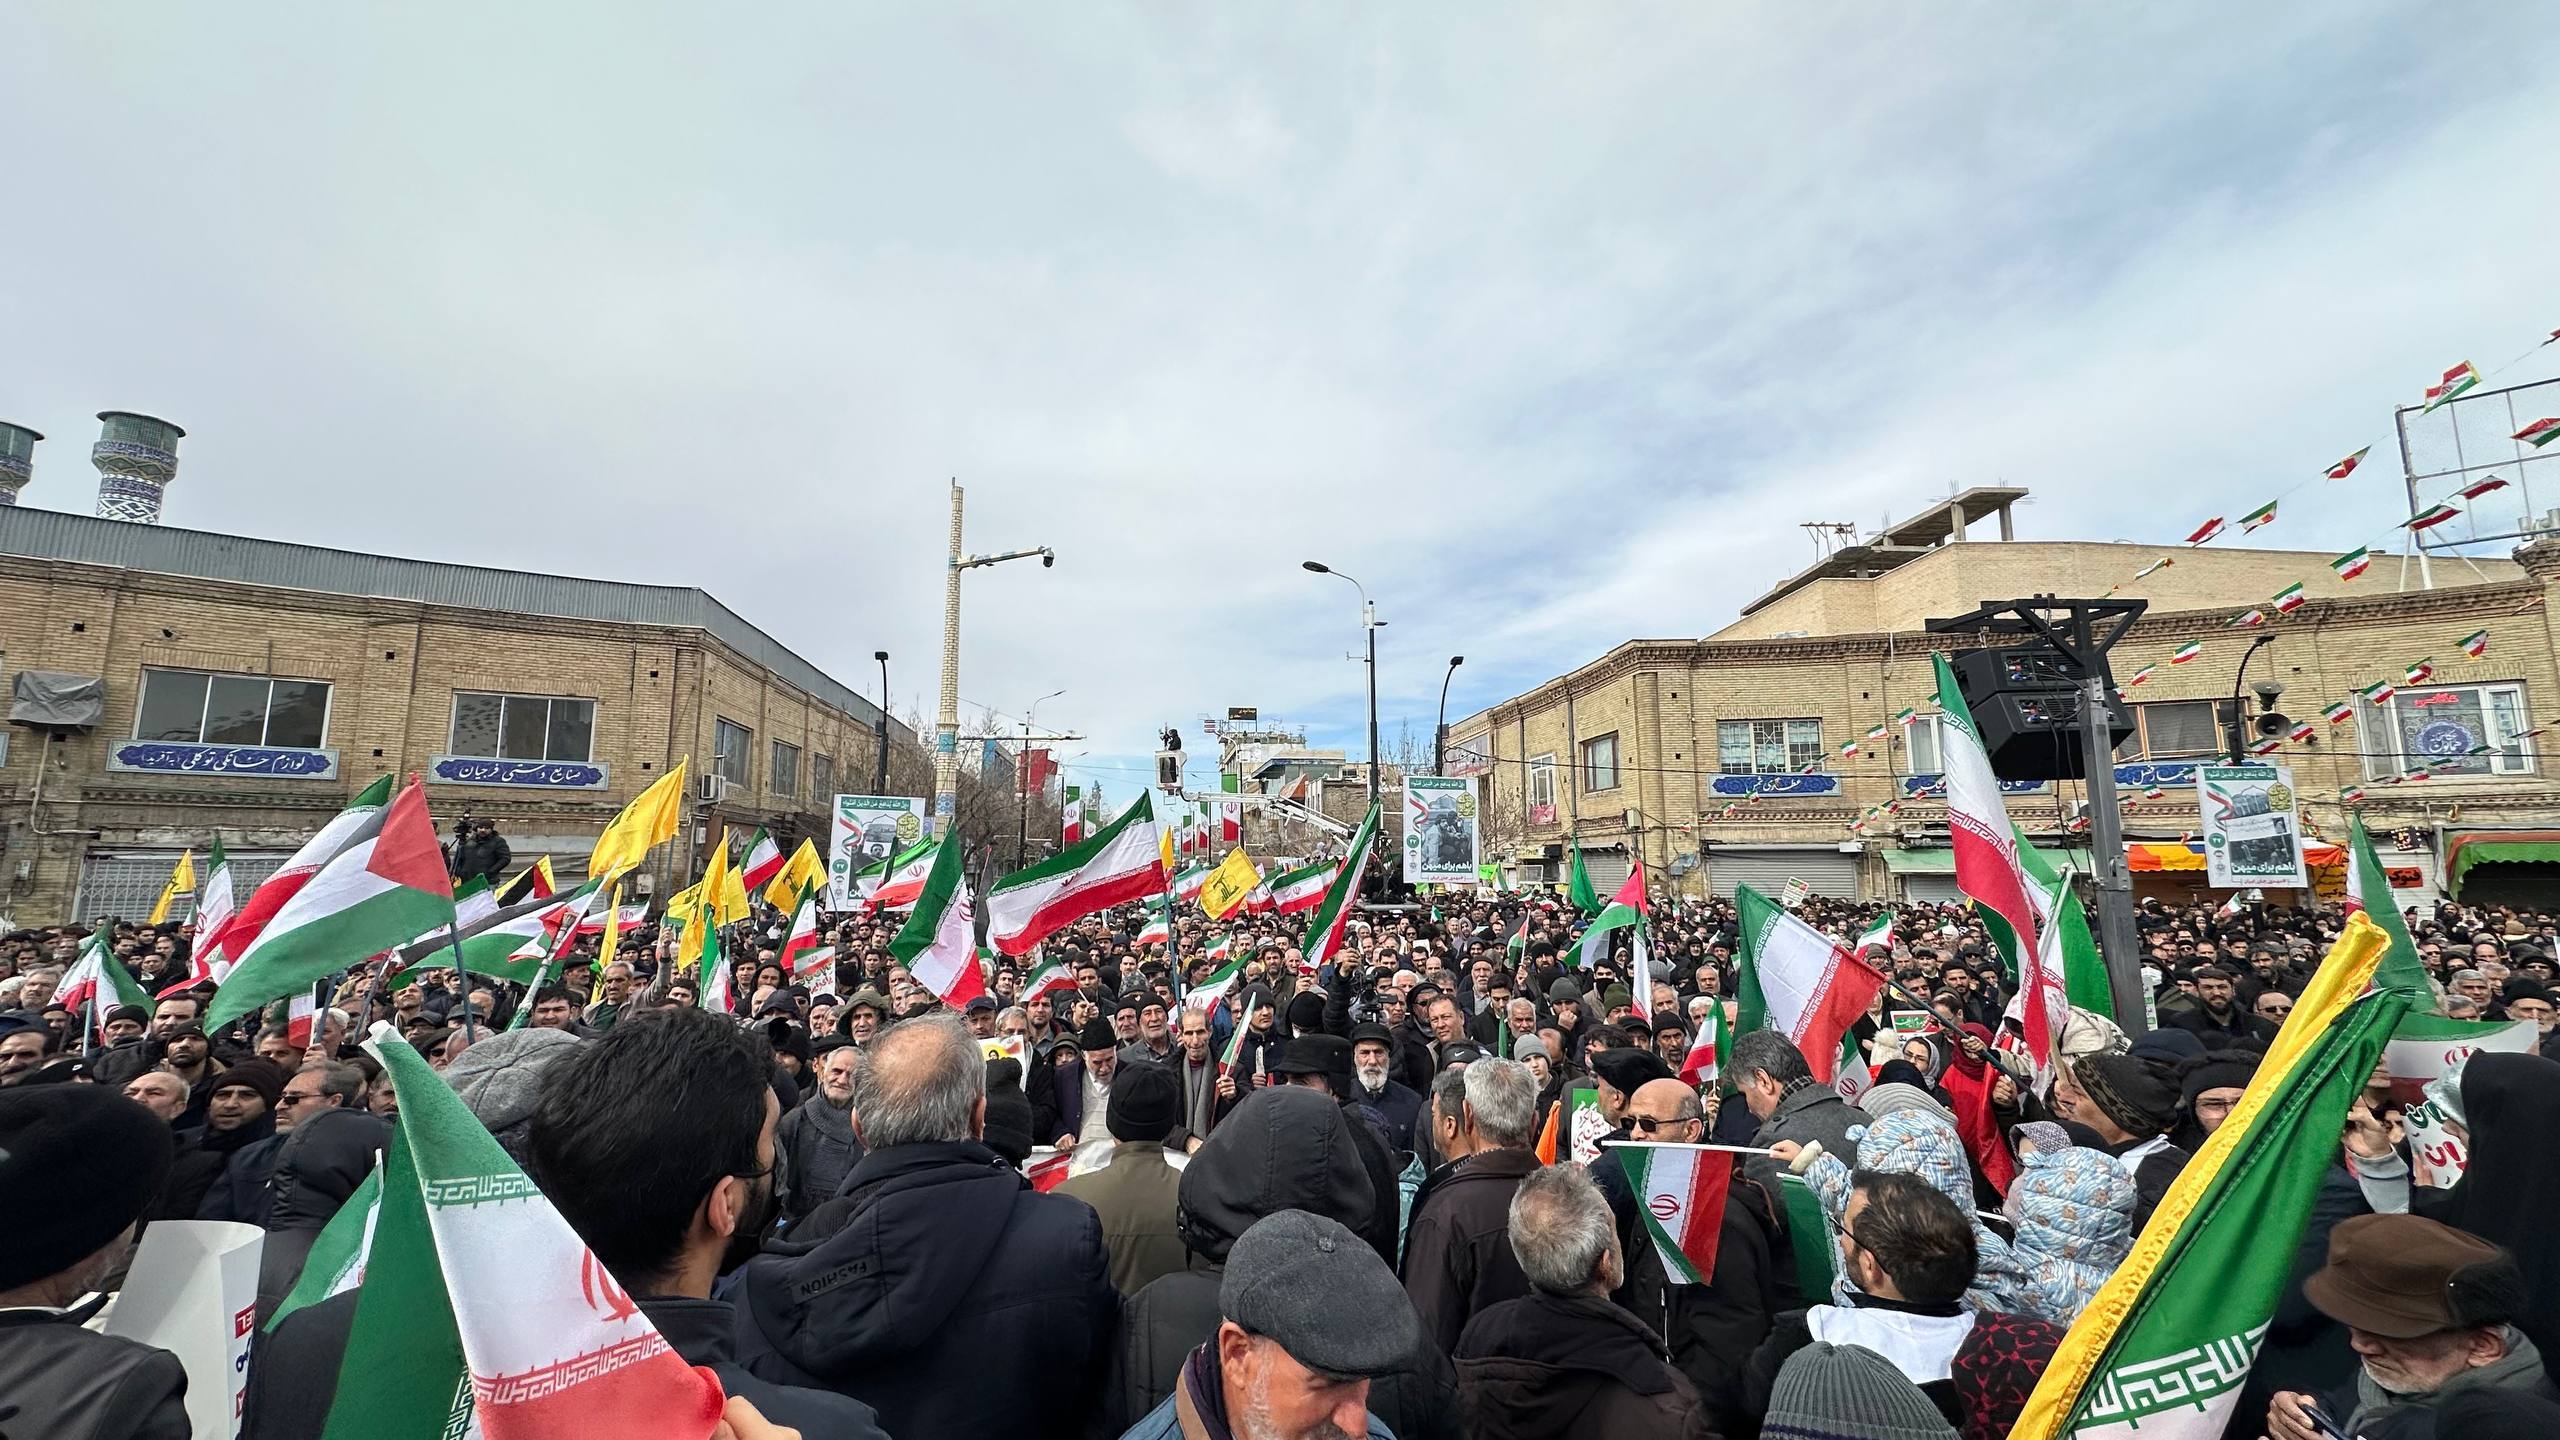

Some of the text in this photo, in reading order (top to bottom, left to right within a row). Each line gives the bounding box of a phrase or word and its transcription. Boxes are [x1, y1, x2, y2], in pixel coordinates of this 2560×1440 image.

[181, 747, 216, 770] توکلی
[213, 748, 268, 771] خانگی
[271, 754, 305, 775] لوازم
[458, 763, 581, 783] صنایع دستی فرجیان
[1422, 863, 1441, 871] میهن
[1442, 861, 1455, 871] برای
[1456, 861, 1472, 872] باهم
[2231, 861, 2296, 873] باهم برای میهن
